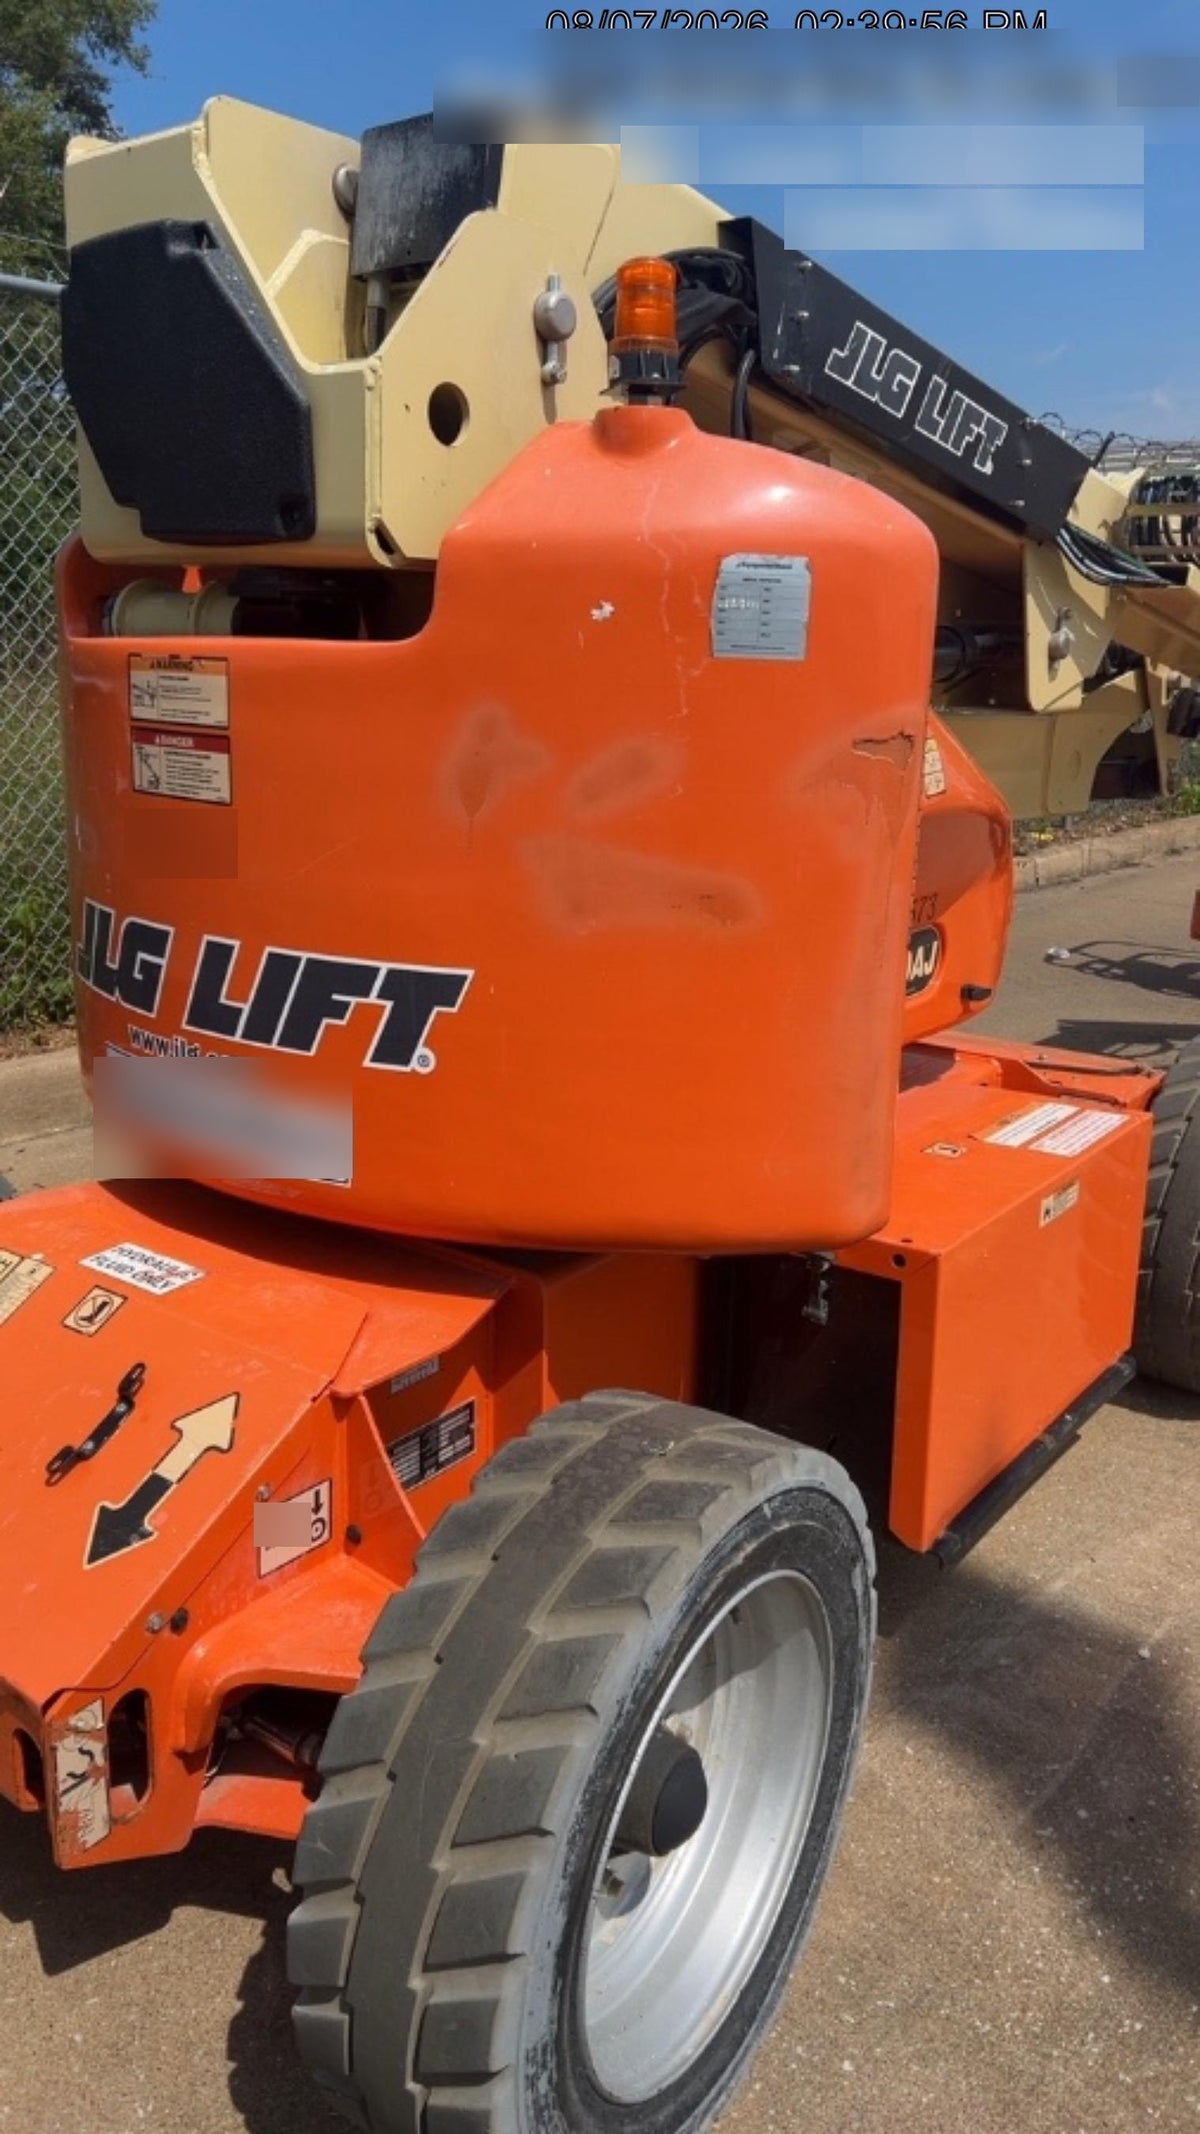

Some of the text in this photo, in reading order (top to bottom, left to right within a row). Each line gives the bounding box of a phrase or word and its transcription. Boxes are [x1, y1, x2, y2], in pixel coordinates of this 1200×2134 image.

[825, 320, 1009, 475] JLG LIFT
[77, 897, 174, 1018] JLG
